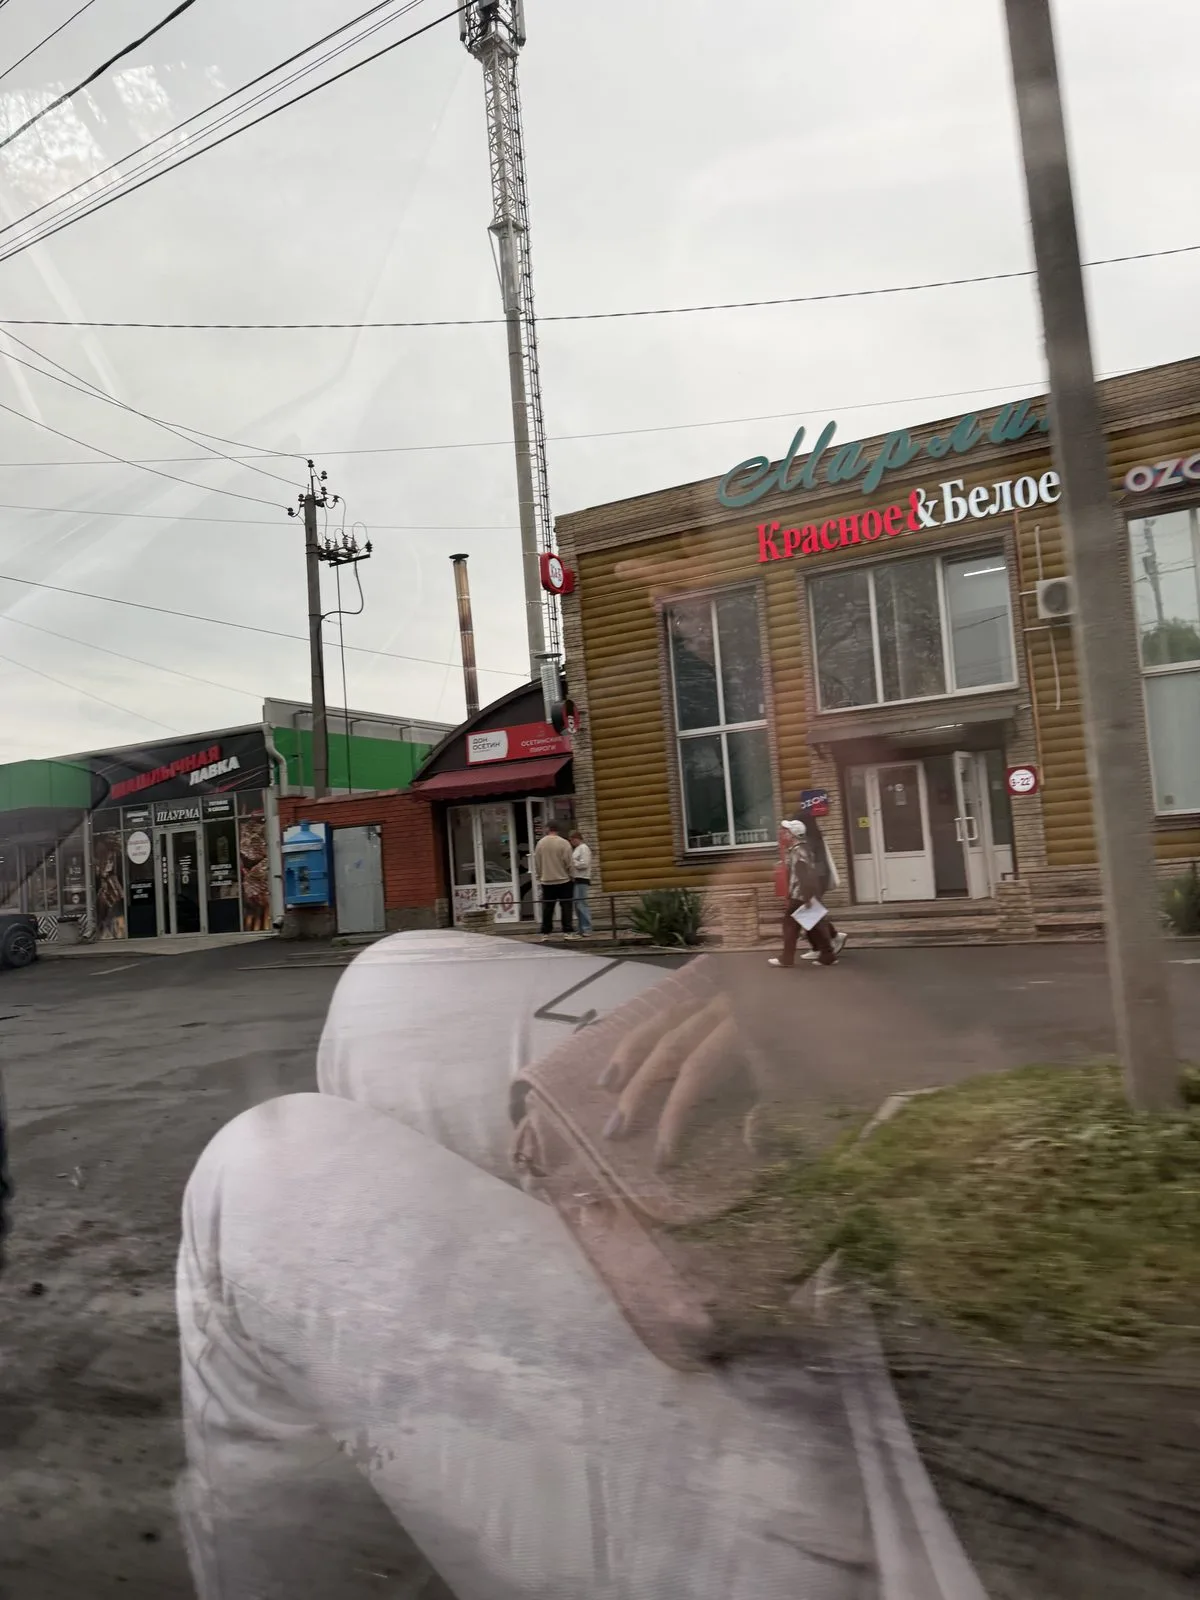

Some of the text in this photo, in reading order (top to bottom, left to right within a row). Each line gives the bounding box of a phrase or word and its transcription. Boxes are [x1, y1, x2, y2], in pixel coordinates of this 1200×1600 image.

[717, 399, 1050, 508] Марли
[111, 746, 221, 799] ШАШЛЫЧНАЯ
[189, 755, 240, 786] ЛАВКА
[156, 807, 200, 822] ШАУРМА
